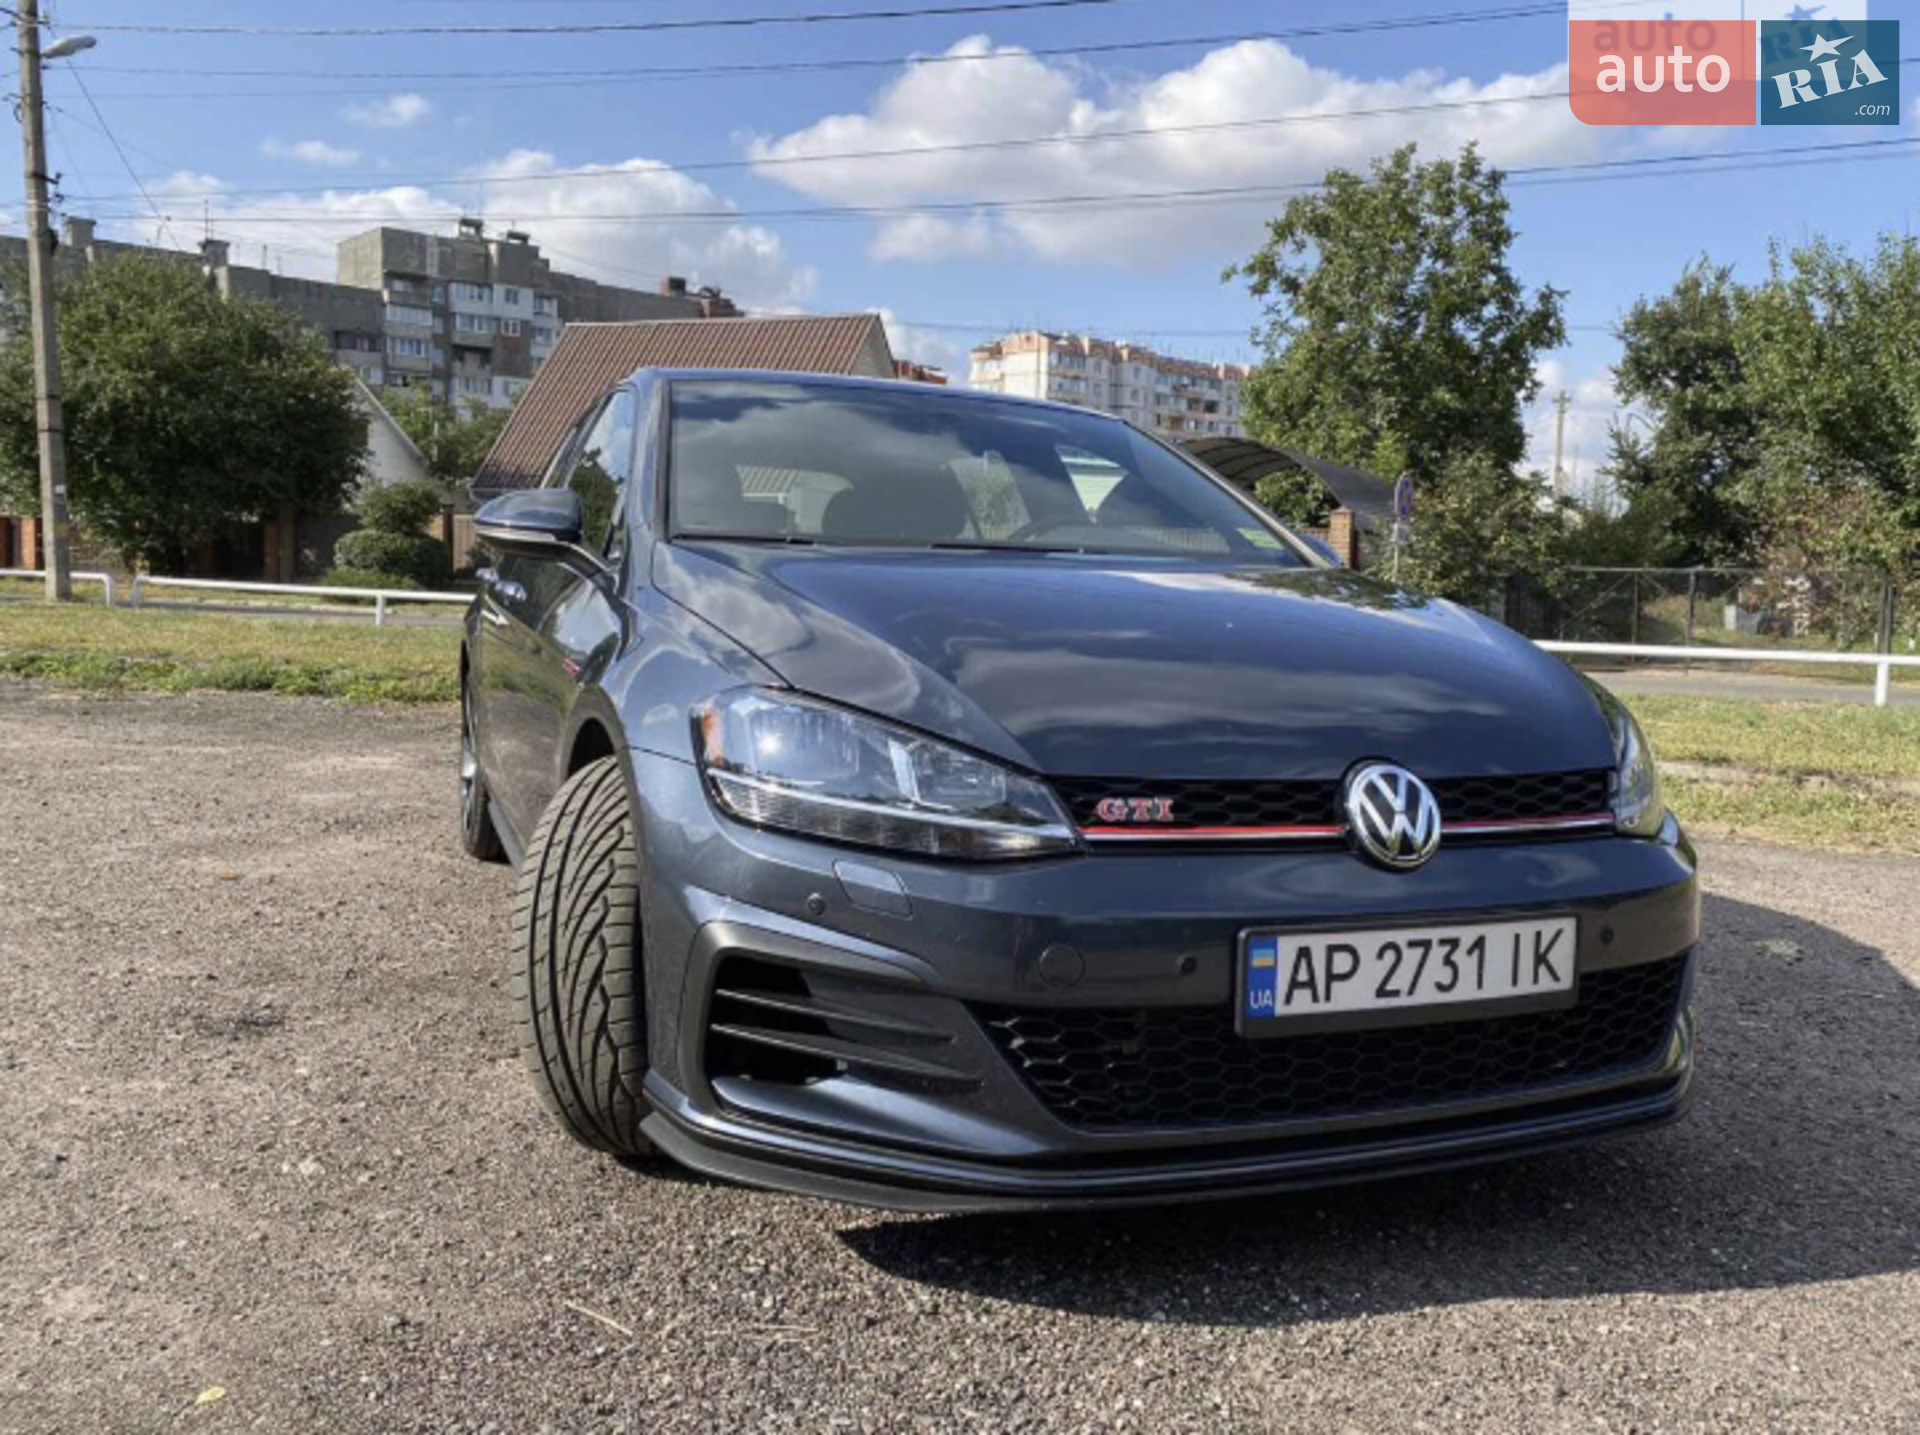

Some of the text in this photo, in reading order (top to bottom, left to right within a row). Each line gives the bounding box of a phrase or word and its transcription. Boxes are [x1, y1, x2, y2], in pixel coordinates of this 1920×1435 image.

[1096, 797, 1174, 822] GTI
[1350, 765, 1441, 866] VW
[1283, 928, 1565, 1006] AP 2731 IK
[1250, 991, 1274, 1009] UA
